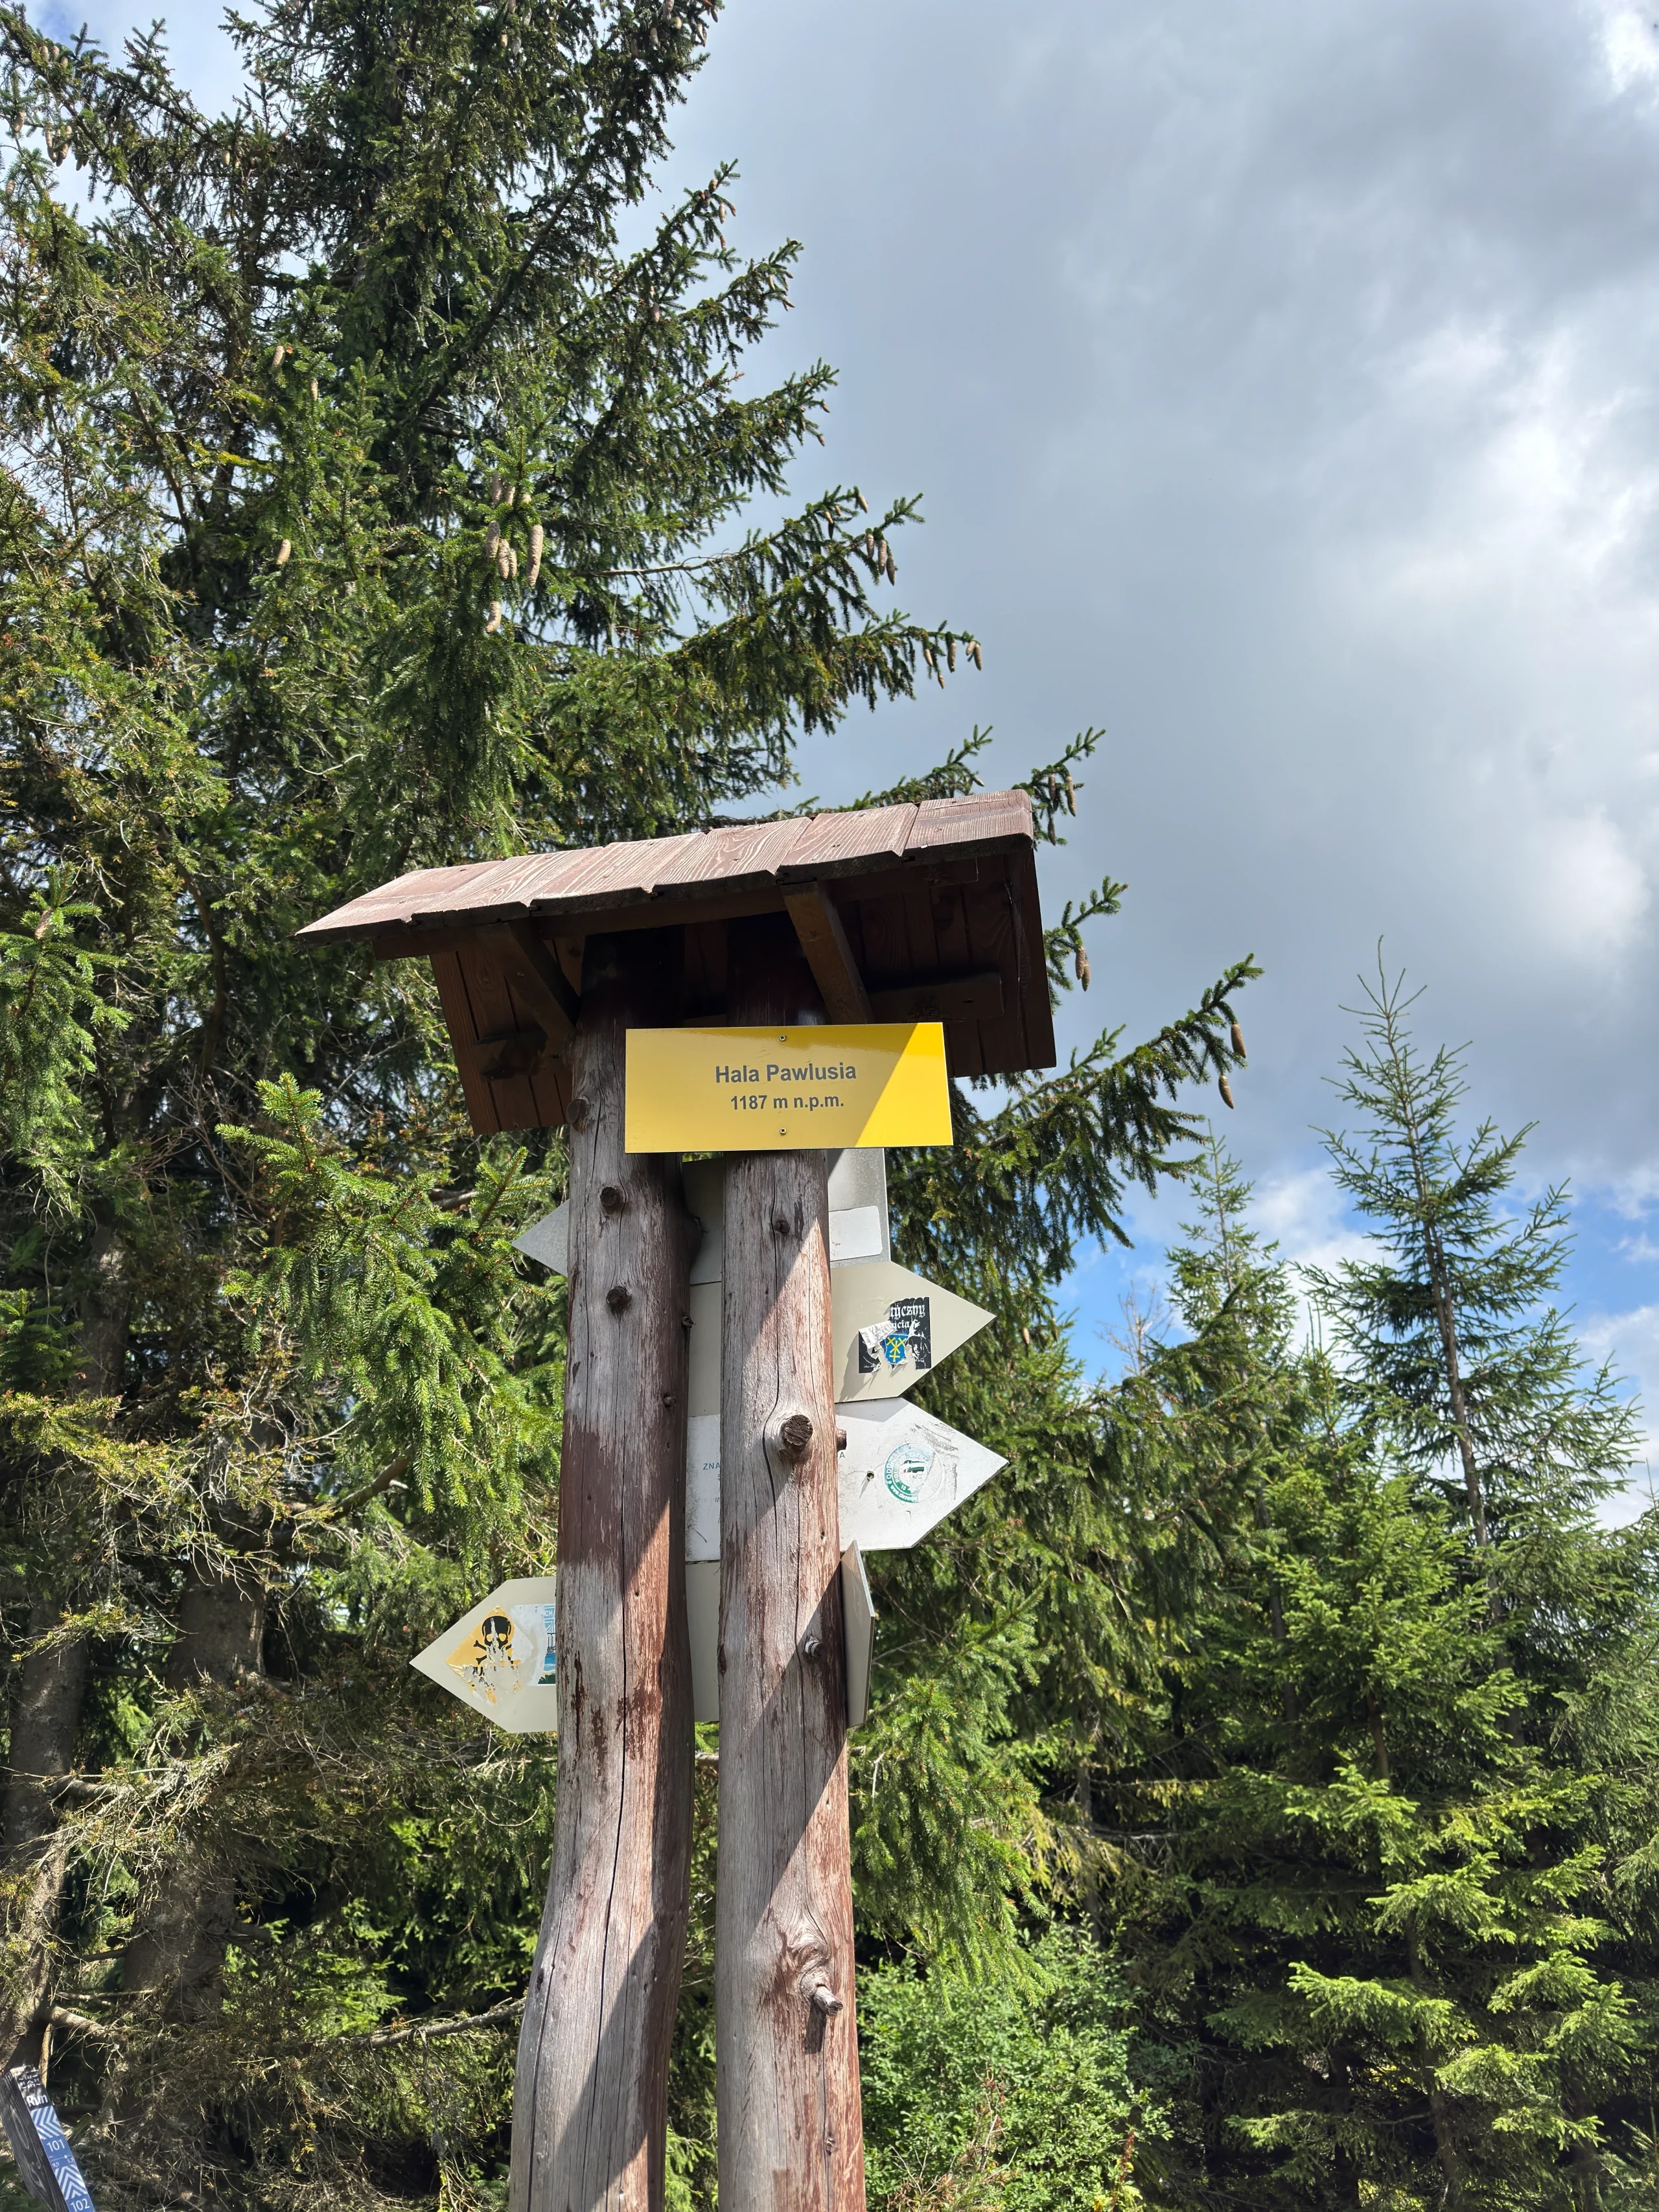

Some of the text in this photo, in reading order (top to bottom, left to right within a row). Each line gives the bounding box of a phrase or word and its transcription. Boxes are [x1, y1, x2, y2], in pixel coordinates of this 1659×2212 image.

[715, 1062, 857, 1083] Hala Pawlusia
[730, 1095, 844, 1111] 1187 m n.p.m.
[27, 2095, 48, 2106] Run
[47, 2139, 65, 2152] 101
[70, 2198, 90, 2212] 102
